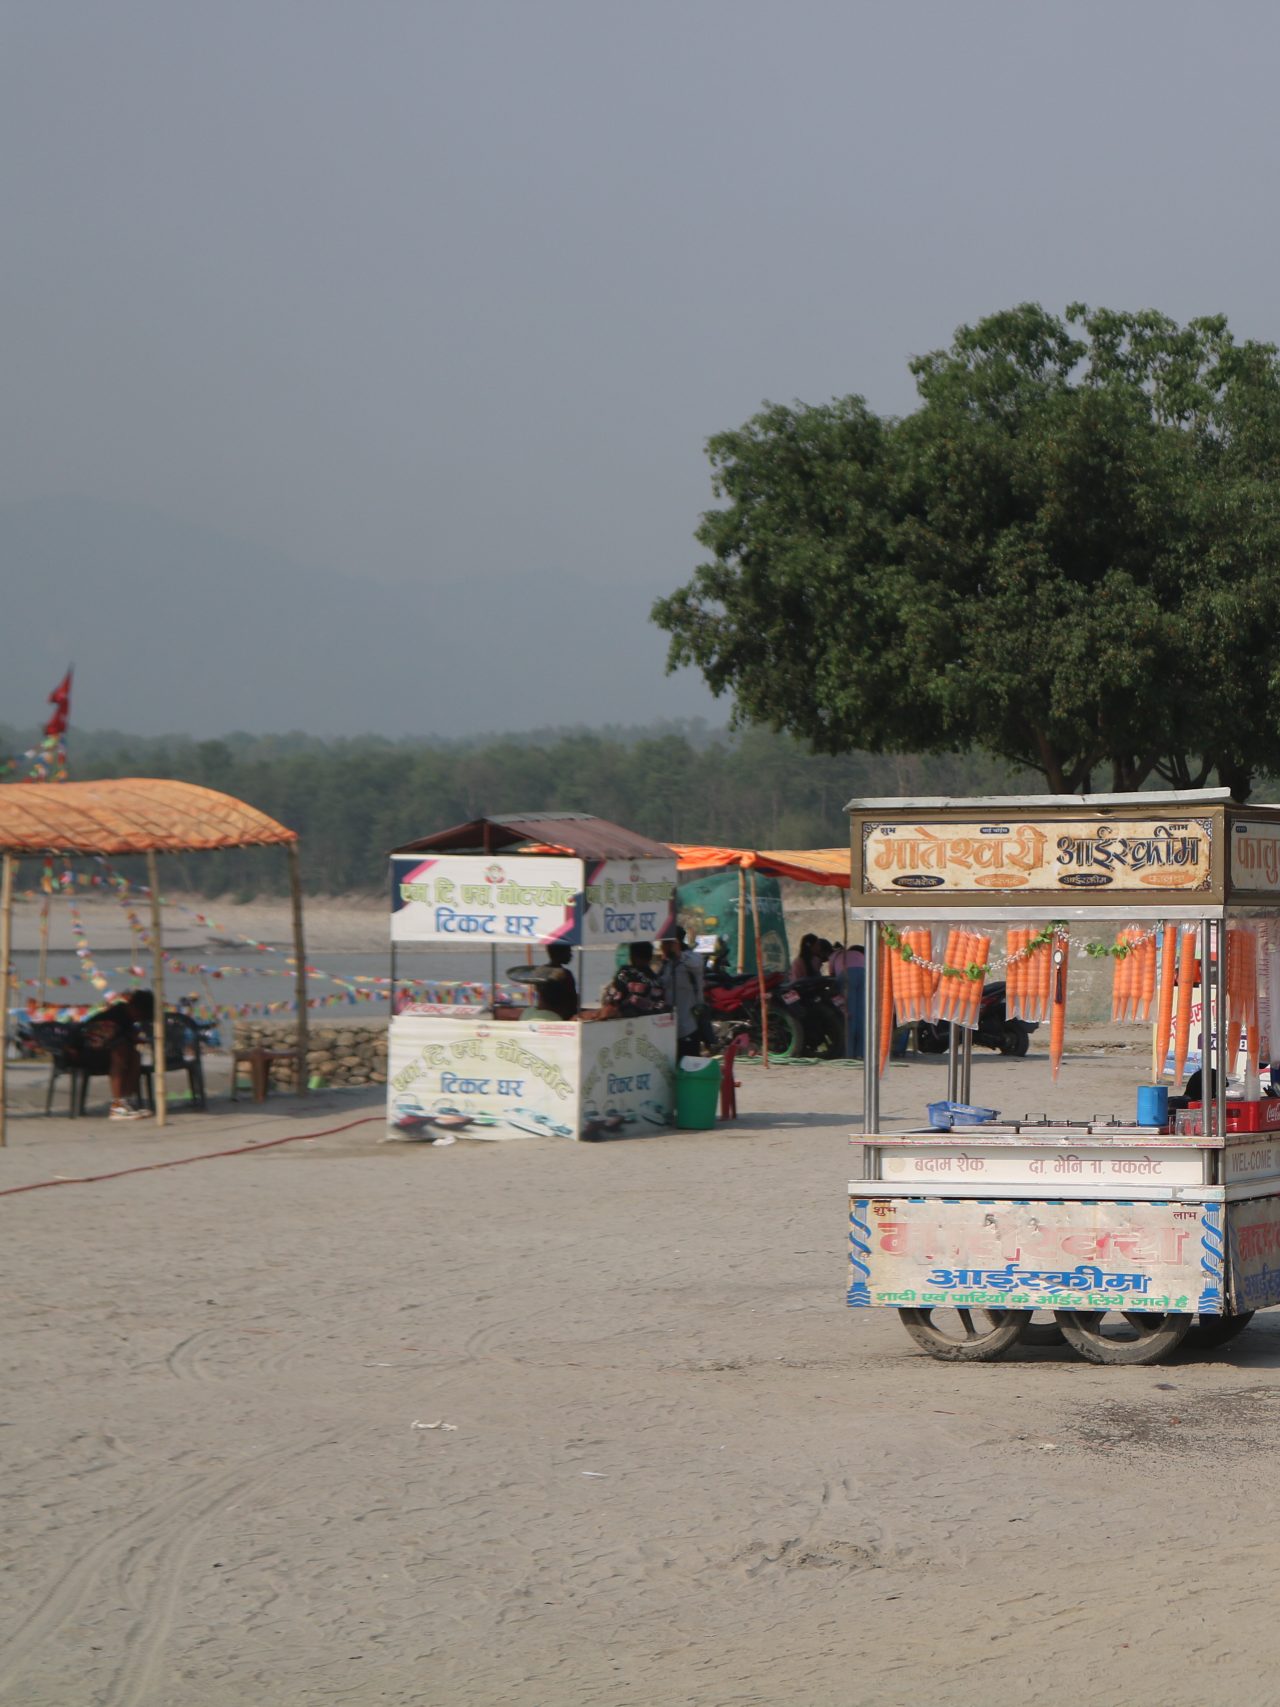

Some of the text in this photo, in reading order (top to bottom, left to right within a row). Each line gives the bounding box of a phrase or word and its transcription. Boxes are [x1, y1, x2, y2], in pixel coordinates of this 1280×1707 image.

[880, 827, 896, 836] शुभ
[1168, 823, 1188, 831] लाभ
[874, 825, 1048, 871] मातेश्वरी
[436, 907, 538, 935] टिकट घर
[604, 907, 657, 933] टिकट घर
[441, 1072, 525, 1097] टिकट घर
[607, 1073, 634, 1095] टिकट
[915, 1158, 951, 1173] बदाम
[1111, 1155, 1163, 1175] चकलेट
[1232, 1149, 1272, 1174] WEL-COME
[873, 1206, 897, 1216] शुभ
[1173, 1211, 1197, 1220] लाभ
[926, 1264, 1152, 1295] आईस्क्रीम
[876, 1289, 916, 1303] शादी
[1011, 1293, 1033, 1305] के
[1087, 1294, 1124, 1306] लिये
[1130, 1295, 1170, 1308] जाते
[1174, 1295, 1189, 1309] है
